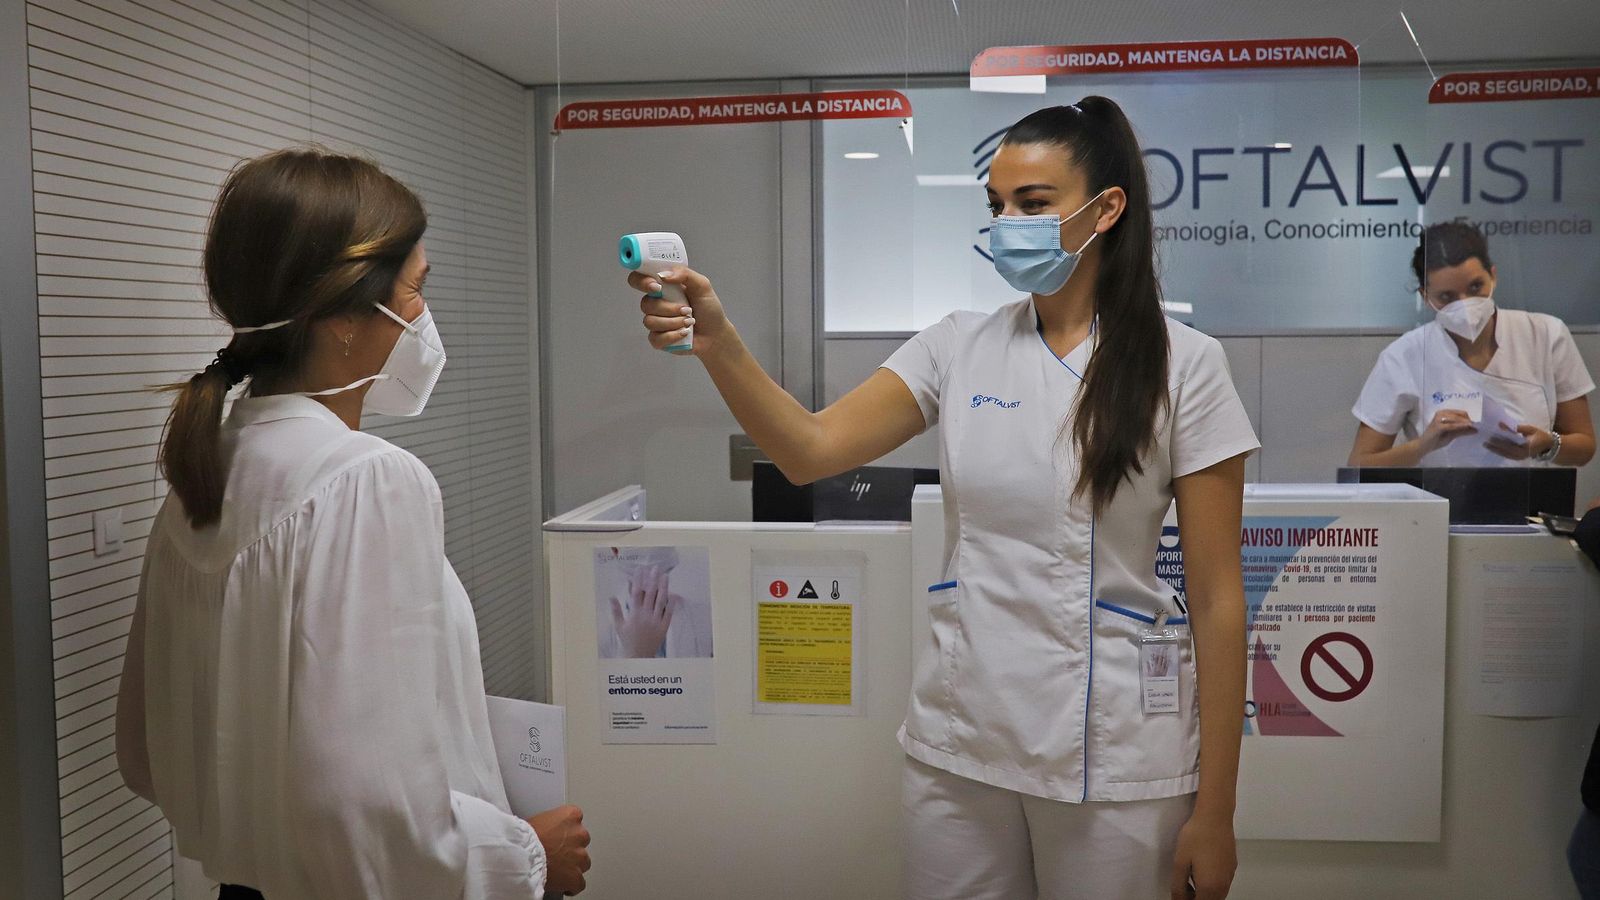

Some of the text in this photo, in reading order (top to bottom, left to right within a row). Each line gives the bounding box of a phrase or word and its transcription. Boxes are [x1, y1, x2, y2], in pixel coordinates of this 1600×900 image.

[1023, 52, 1124, 67] SEGURIDAD,
[1128, 49, 1224, 64] MANTENGA
[1229, 48, 1251, 62] LA
[1255, 45, 1347, 61] DISTANCIA
[1444, 77, 1592, 96] POR SEGURIDAD,
[567, 97, 903, 122] POR SEGURIDAD, MANTENGA LA DISTANCIA
[1144, 138, 1584, 211] OFTALVIST
[1264, 217, 1424, 240] Conocimiento
[850, 474, 871, 502] hp
[1240, 527, 1379, 547] AVISO IMPORTANTE
[1300, 554, 1307, 563] la
[1307, 554, 1340, 564] prevención
[1341, 554, 1351, 563] del
[1351, 554, 1367, 563] virus
[1367, 554, 1377, 563] del
[1157, 564, 1185, 575] MASC
[1284, 564, 1312, 574] Covid-19,
[1313, 565, 1321, 573] es
[1323, 564, 1346, 574] preciso
[1348, 564, 1368, 573] limitar
[1370, 564, 1377, 573] la
[1281, 574, 1289, 583] de
[1297, 575, 1325, 583] personas
[1333, 575, 1342, 583] en
[1350, 574, 1377, 583] entornos
[1265, 604, 1274, 612] se
[1274, 603, 1304, 612] establece
[1305, 603, 1312, 612] la
[1313, 603, 1346, 612] restricción
[1347, 603, 1355, 612] de
[1356, 604, 1376, 613] visitas
[1252, 613, 1282, 622] familiares
[1287, 614, 1292, 622] a
[1304, 614, 1330, 623] persona
[1333, 614, 1344, 623] por
[1348, 614, 1376, 623] paciente
[1273, 643, 1281, 651] su
[608, 674, 682, 684] Está usted en un
[608, 686, 683, 697] entorno seguro
[1260, 702, 1281, 717] HLA
